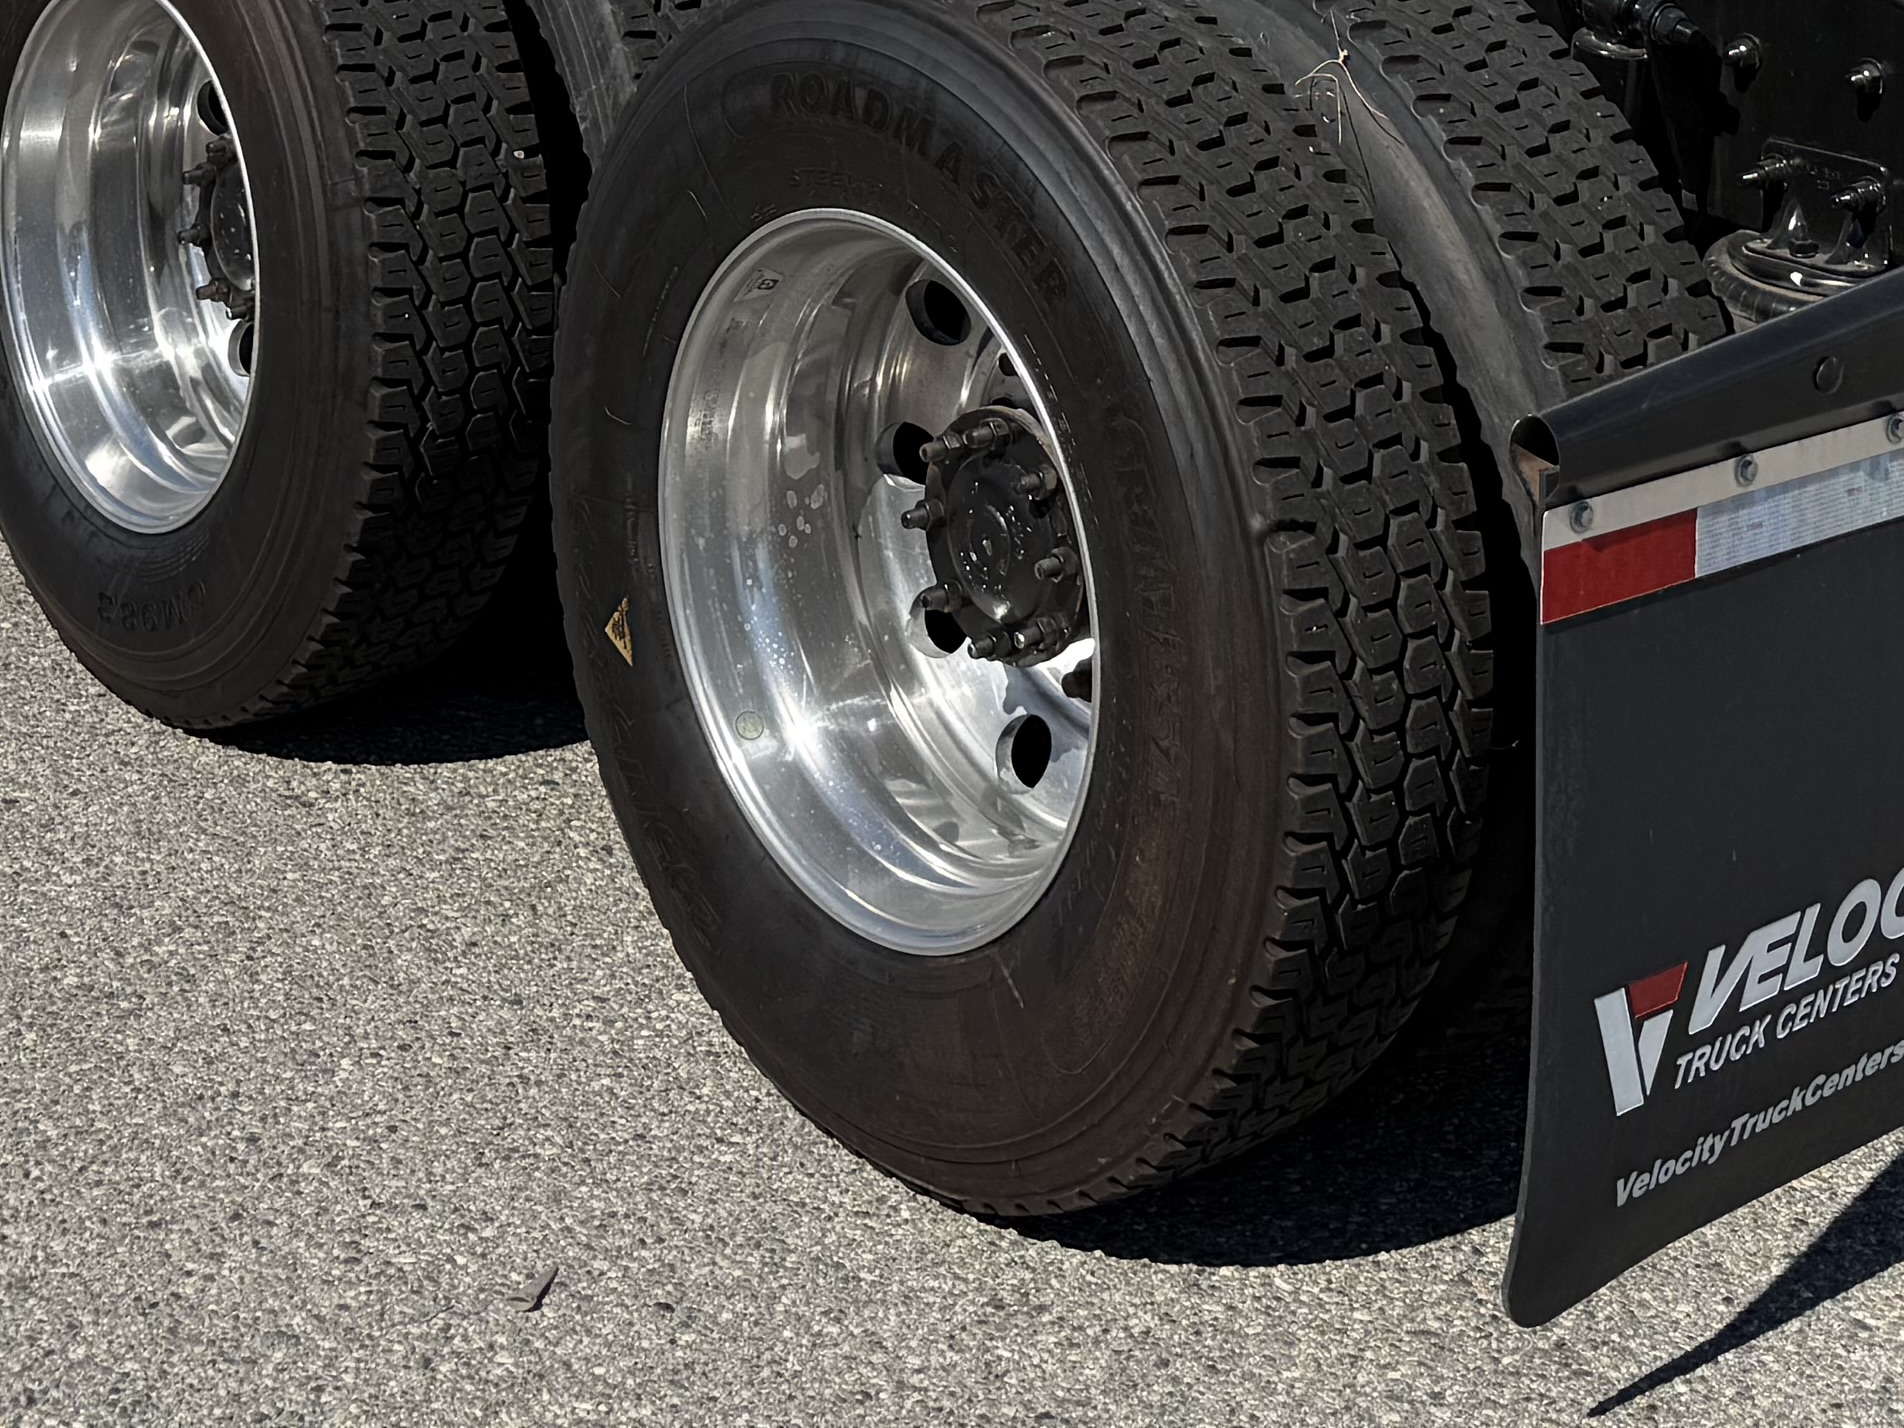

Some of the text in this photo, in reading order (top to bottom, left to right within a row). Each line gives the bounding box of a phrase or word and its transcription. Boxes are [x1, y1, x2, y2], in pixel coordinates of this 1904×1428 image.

[769, 70, 1069, 304] ROADMASTER
[1673, 953, 1900, 1089] TRUCK CENTERS
